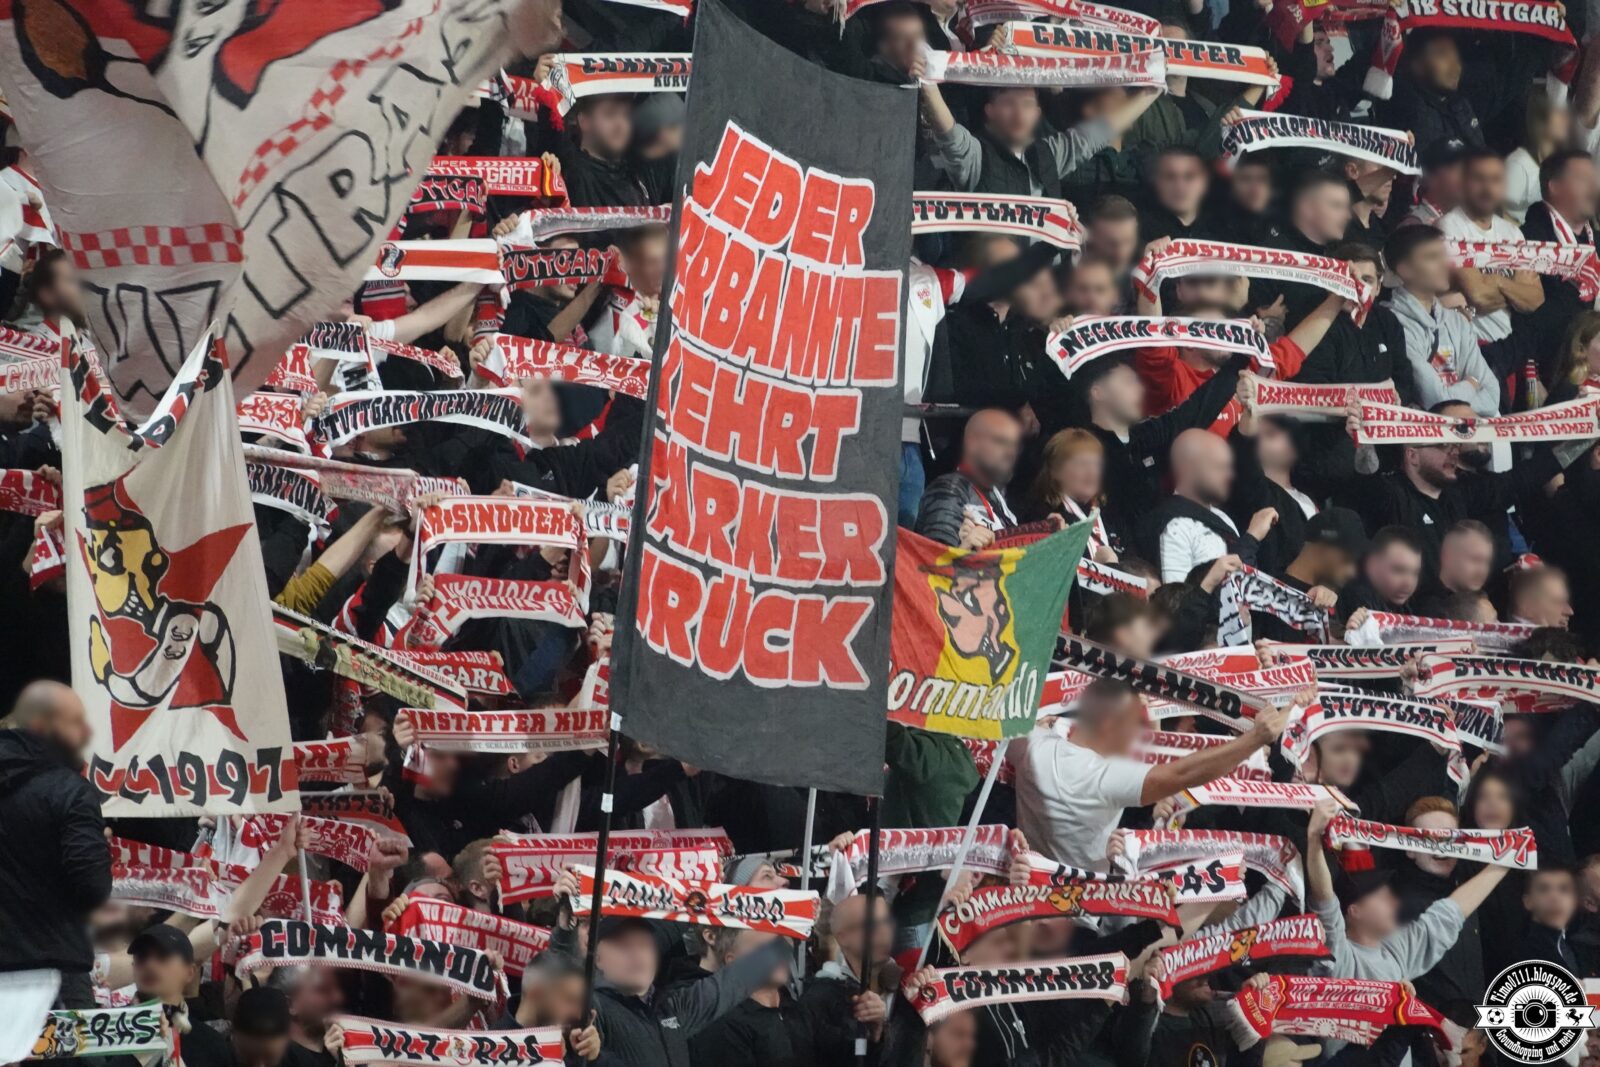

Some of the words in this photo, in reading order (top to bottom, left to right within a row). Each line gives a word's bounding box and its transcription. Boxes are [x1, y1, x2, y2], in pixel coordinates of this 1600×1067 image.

[1314, 119, 1421, 169] INTERNATION
[692, 119, 876, 268] JEDER
[912, 200, 1051, 228] TUTTGART
[502, 247, 613, 282] TUTTGART
[1060, 319, 1151, 358] NECKAR
[1187, 320, 1270, 356] STADIO
[1364, 425, 1444, 438] VERGEHEN
[1495, 426, 1517, 438] IST
[1551, 422, 1595, 436] IMMER
[451, 503, 511, 534] SIND
[520, 506, 565, 537] DER
[887, 661, 1038, 721] ommando
[1261, 662, 1314, 687] KURVE
[554, 710, 611, 732] KUR
[1236, 780, 1316, 799] Stuttgart
[945, 884, 1052, 936] COMMANDO
[260, 919, 495, 993] COMMANDO
[1165, 932, 1235, 975] OMMANDO
[944, 961, 1116, 1002] COMMANDO
